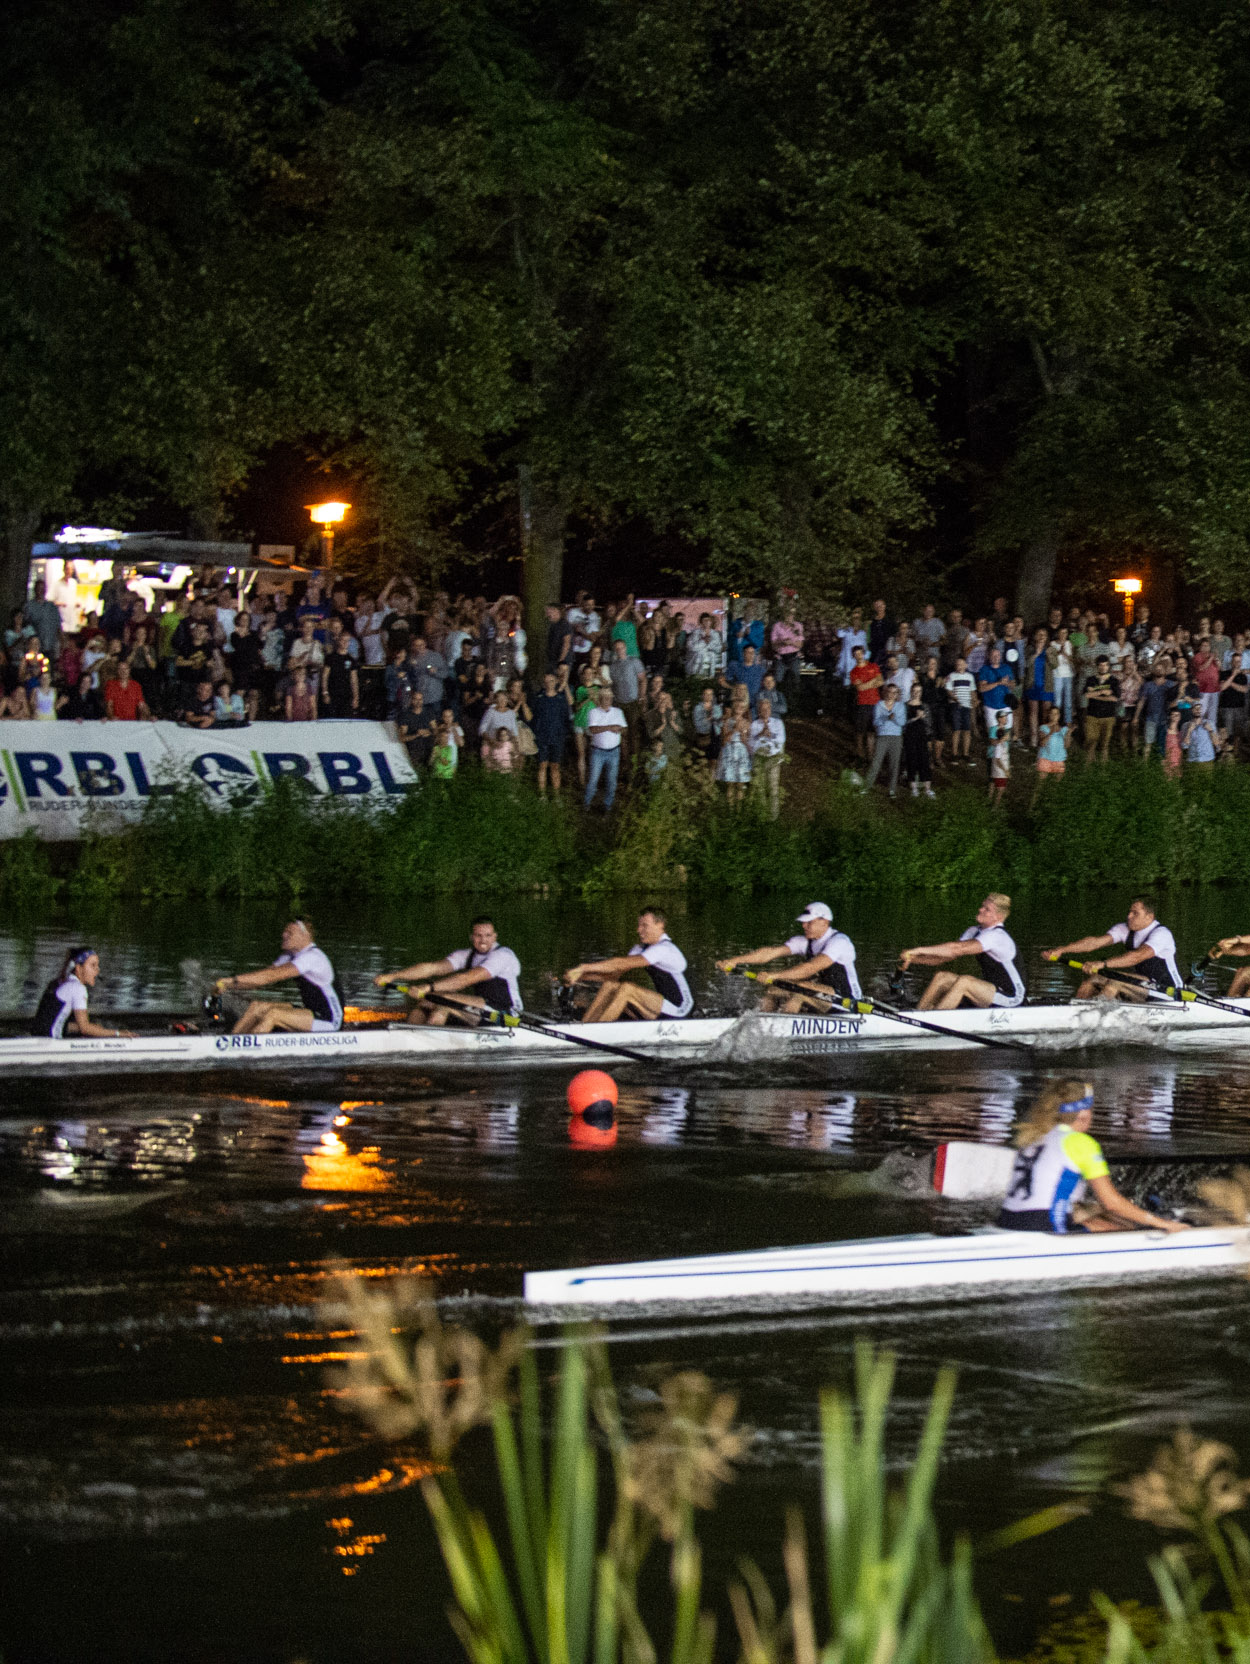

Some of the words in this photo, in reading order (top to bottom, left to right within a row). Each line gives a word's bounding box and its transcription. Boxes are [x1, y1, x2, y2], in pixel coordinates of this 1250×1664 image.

[14, 751, 180, 797] RBL
[263, 751, 418, 795] RBL
[231, 1035, 262, 1048] RBL
[265, 1036, 358, 1048] RUDER-BUNDESLIGA
[791, 1018, 860, 1036] MINDEN
